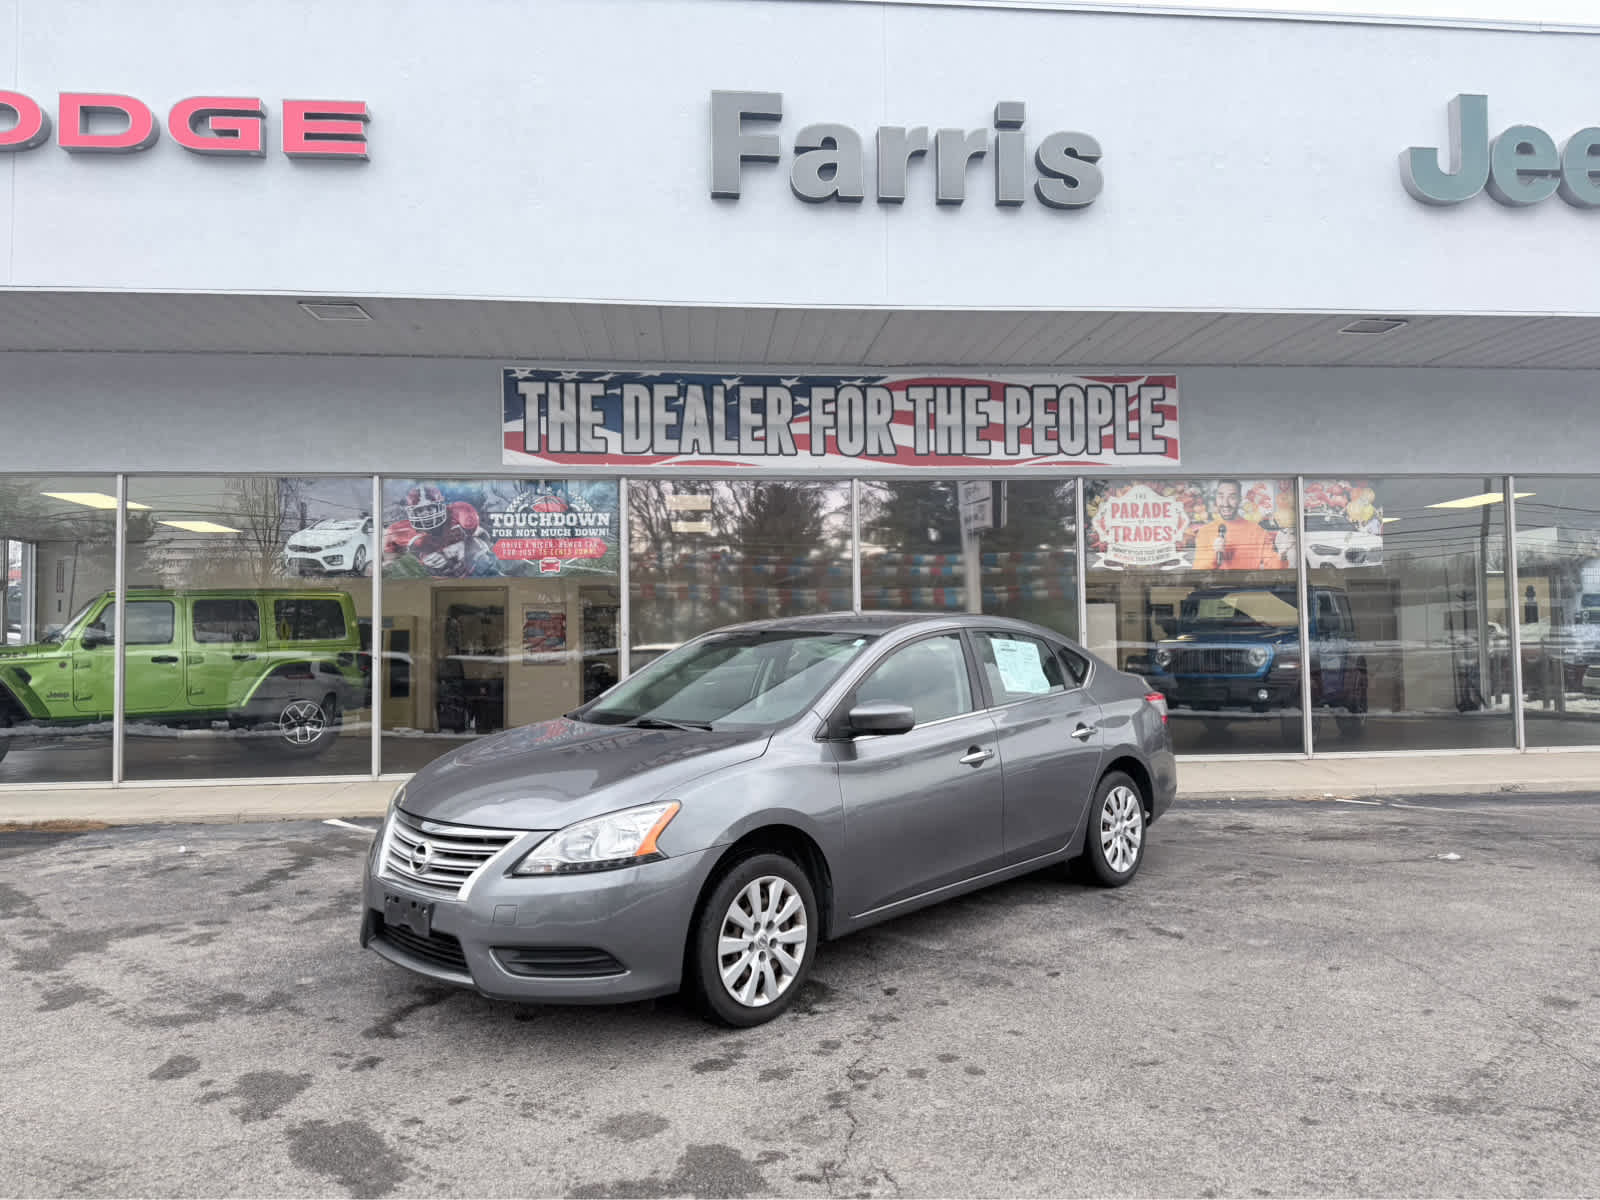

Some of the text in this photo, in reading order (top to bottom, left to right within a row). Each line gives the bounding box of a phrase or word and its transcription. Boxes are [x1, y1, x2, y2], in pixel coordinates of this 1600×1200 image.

[710, 90, 1103, 209] Farris
[1399, 93, 1600, 208] Jee
[516, 379, 1168, 457] THE DEALER FOR THE PEOPLE
[489, 512, 610, 526] TOUCHDOWN
[1111, 502, 1172, 519] PARADE
[492, 528, 609, 537] FOR NOT MUCH DOWN!
[1112, 525, 1173, 543] TRADES
